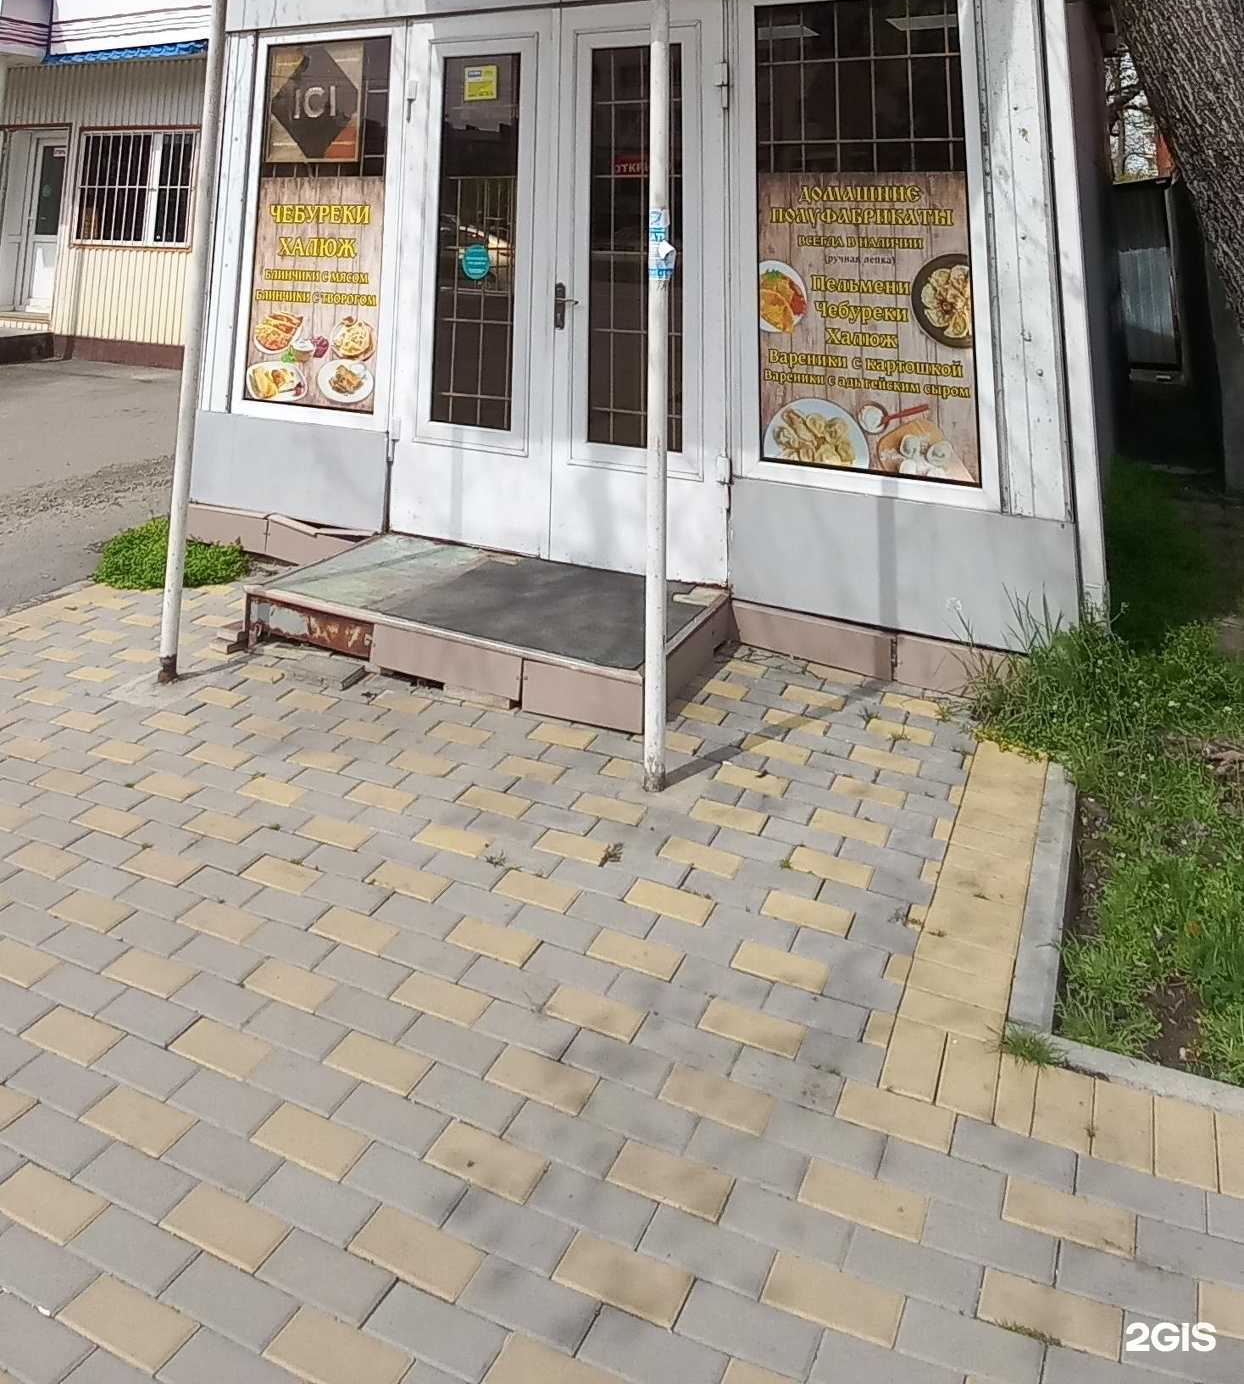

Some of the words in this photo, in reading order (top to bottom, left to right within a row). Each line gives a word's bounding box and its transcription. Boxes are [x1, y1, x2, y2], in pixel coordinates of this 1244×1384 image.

[799, 184, 922, 204] ДОМАШНИЕ
[270, 203, 371, 225] ЧЕБУРЕКИ
[770, 206, 954, 228] ПОЛУФАБРИКАТЫ
[278, 236, 358, 258] ХАЛЮЖ
[798, 235, 845, 248] ВСЕГДА
[846, 236, 857, 248] В
[859, 236, 924, 250] НАЛИЧИИ
[825, 255, 860, 265] (ручная
[863, 255, 896, 265] лепка)
[264, 269, 320, 282] БЛИНЧИКИ
[321, 271, 329, 282] С
[330, 272, 369, 284] МЯСОМ
[811, 275, 911, 295] Пельмени
[255, 289, 311, 303] БЛИНЧИКИ
[312, 292, 320, 303] С
[321, 292, 377, 306] ТВОРОГОМ
[815, 301, 909, 324] Чебуреки
[826, 327, 899, 348] Халюж
[768, 349, 848, 370] Вареники
[852, 358, 862, 369] с
[865, 358, 964, 379] картошкой
[764, 370, 825, 387] Вареники
[827, 375, 836, 386] с
[837, 376, 921, 395] адыгейским
[923, 385, 971, 400] сыром
